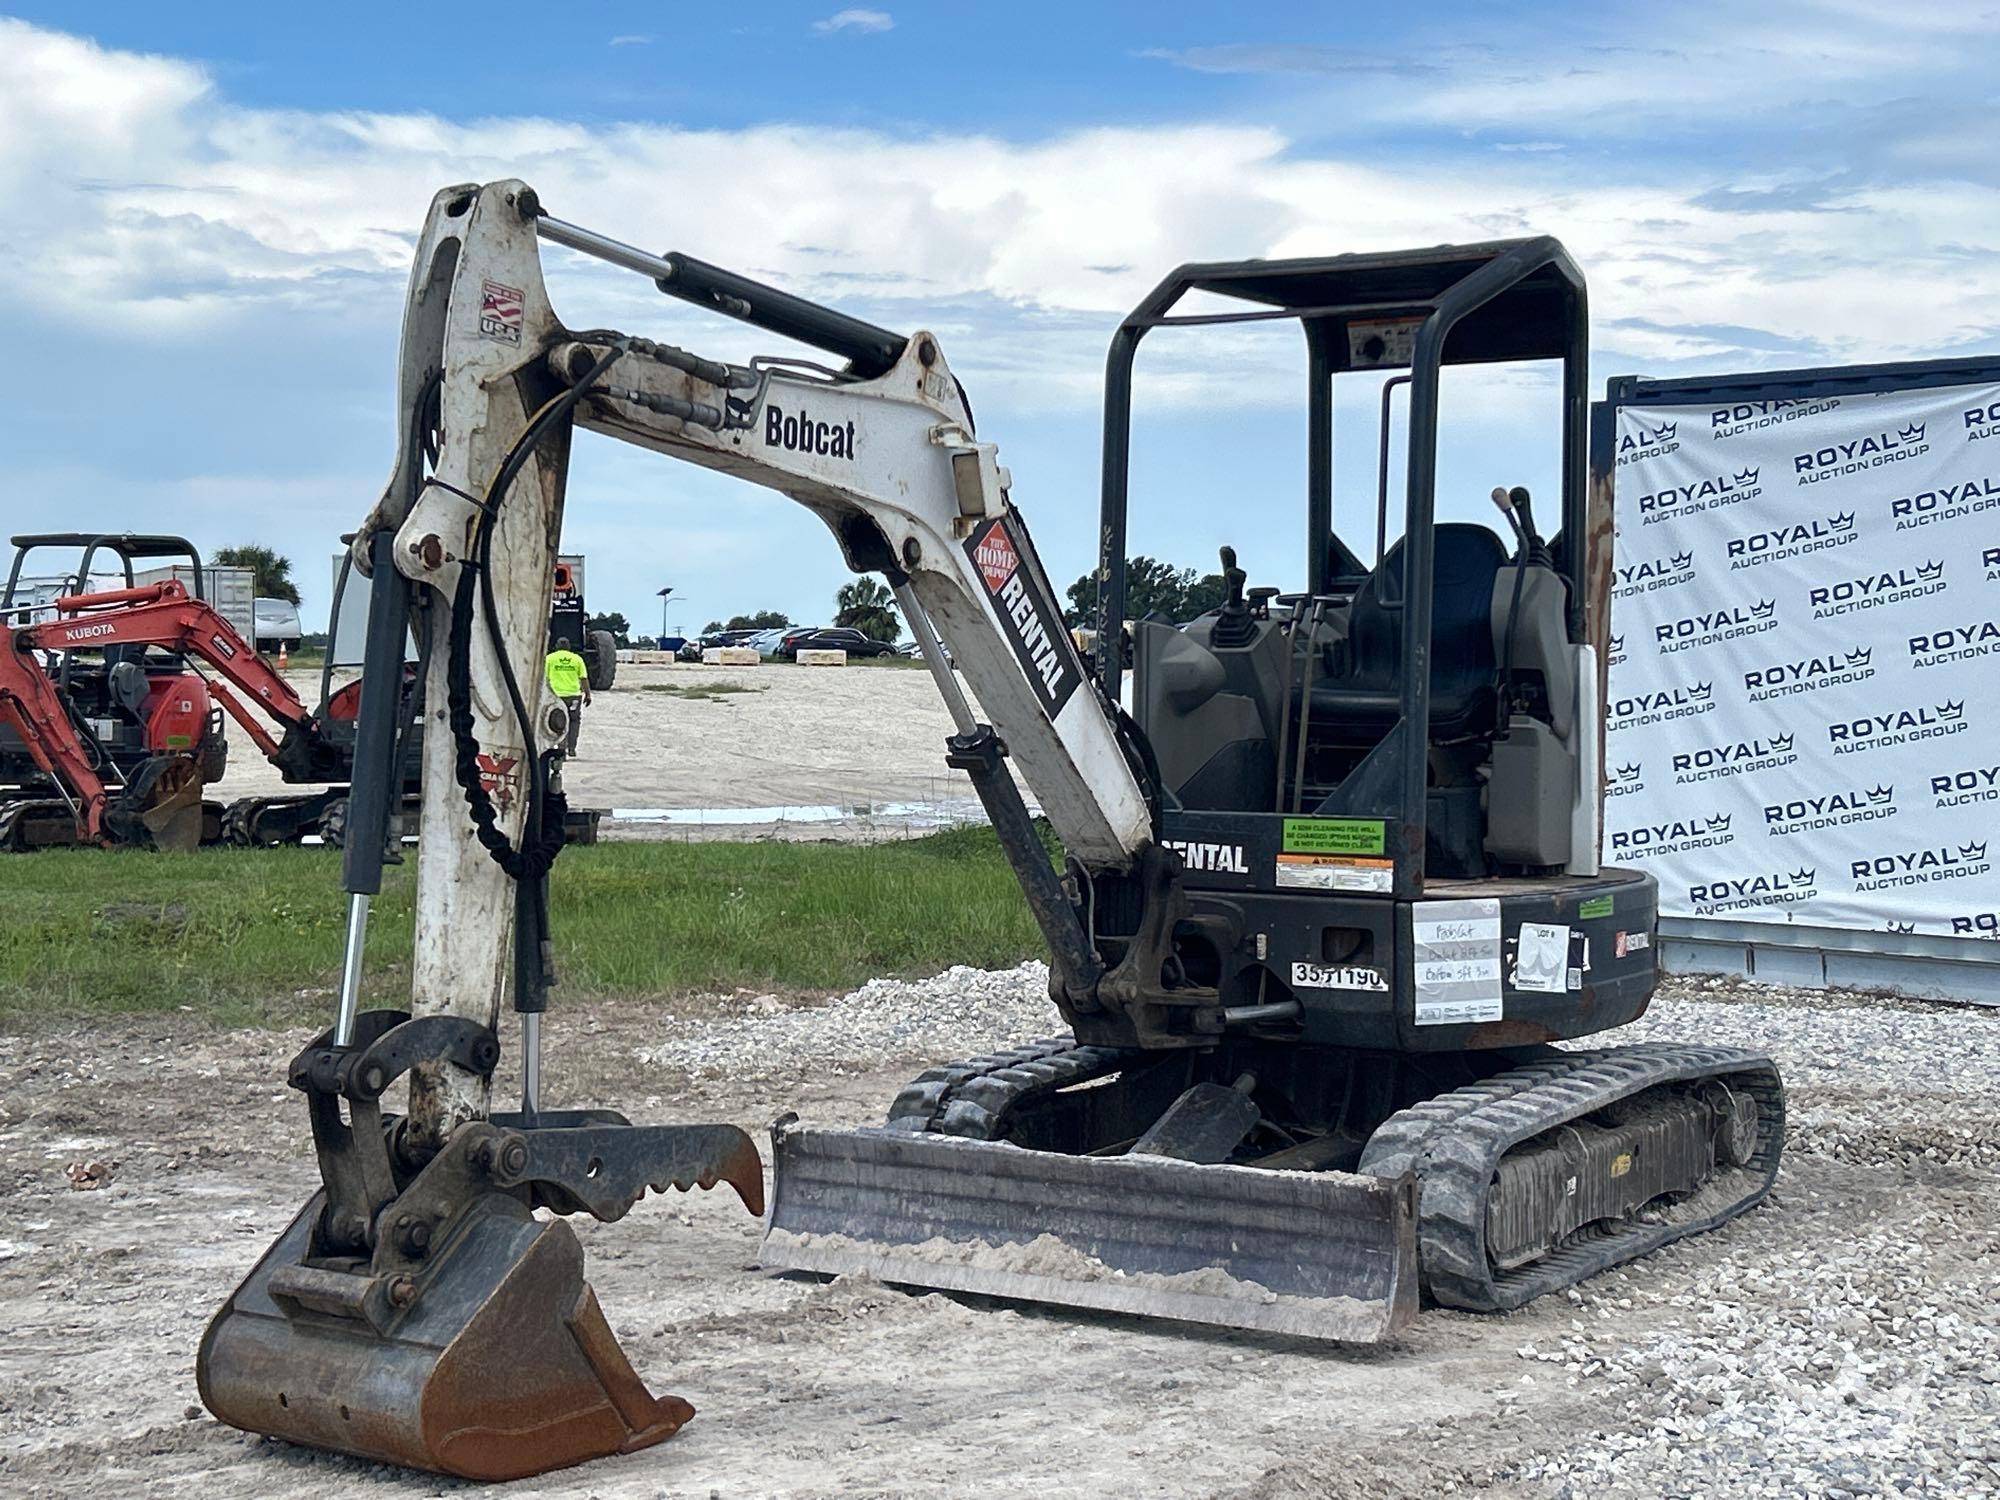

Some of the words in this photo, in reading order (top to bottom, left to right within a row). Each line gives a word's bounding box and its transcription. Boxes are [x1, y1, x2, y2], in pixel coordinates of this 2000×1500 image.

[765, 404, 855, 461] Bobcat
[1713, 415, 1783, 441] AUCTION
[1785, 400, 1841, 421] GROUP
[1631, 442, 1680, 463] GROUP
[1794, 433, 1899, 473] ROYAL
[1798, 460, 1869, 486] AUCTION
[1872, 444, 1930, 467] GROUP
[1639, 476, 1733, 513] ROYAL
[1643, 501, 1706, 526] AUCTION
[1709, 487, 1762, 509] GROUP
[1891, 478, 2000, 518] ROYAL
[1895, 505, 1969, 532] AUCTION
[990, 538, 1006, 549] THE
[1727, 520, 1828, 558] ROYAL
[1730, 547, 1799, 570] AUCTION
[1802, 532, 1859, 553] GROUP
[978, 546, 1017, 570] HOME
[1611, 559, 1671, 587] YAL
[1611, 583, 1645, 599] TION
[1647, 571, 1696, 591] GROUP
[1809, 569, 1916, 607] ROYAL
[1813, 595, 1885, 620] AUCTION
[1888, 581, 1947, 603] GROUP
[66, 624, 116, 640] KUBOTA
[1001, 573, 1065, 701] RENTAL
[1656, 607, 1750, 642] ROYAL
[1659, 632, 1723, 655] AUCTION
[1725, 620, 1778, 640] GROUP
[1744, 655, 1845, 690] ROYAL
[1912, 645, 1988, 669] AUCTION
[1749, 680, 1816, 703] AUCTION
[1819, 668, 1876, 689] GROUP
[1606, 713, 1661, 732] UCTION
[1664, 702, 1716, 721] GROUP
[1829, 708, 1936, 742] ROYAL
[1832, 733, 1905, 756] AUCTION
[1908, 722, 1969, 742] GROUP
[1673, 740, 1769, 772] ROYAL
[1675, 765, 1742, 785] AUCTION
[1745, 754, 1798, 772] GROUP
[1605, 783, 1644, 797] ROUP
[1764, 792, 1867, 823] ROYAL
[1769, 817, 1838, 837] AUCTION
[1840, 806, 1898, 825] GROUP
[1612, 819, 1705, 849] ROYAL
[1615, 844, 1678, 862] AUCTION
[1680, 834, 1735, 851] GROUP
[1851, 848, 1959, 878] ROYAL
[1855, 873, 1928, 893] AUCTION
[1931, 863, 1991, 881] GROUP
[1689, 874, 1788, 903] ROYAL
[1694, 897, 1761, 916] AUCTION
[1764, 889, 1818, 906] GROUP
